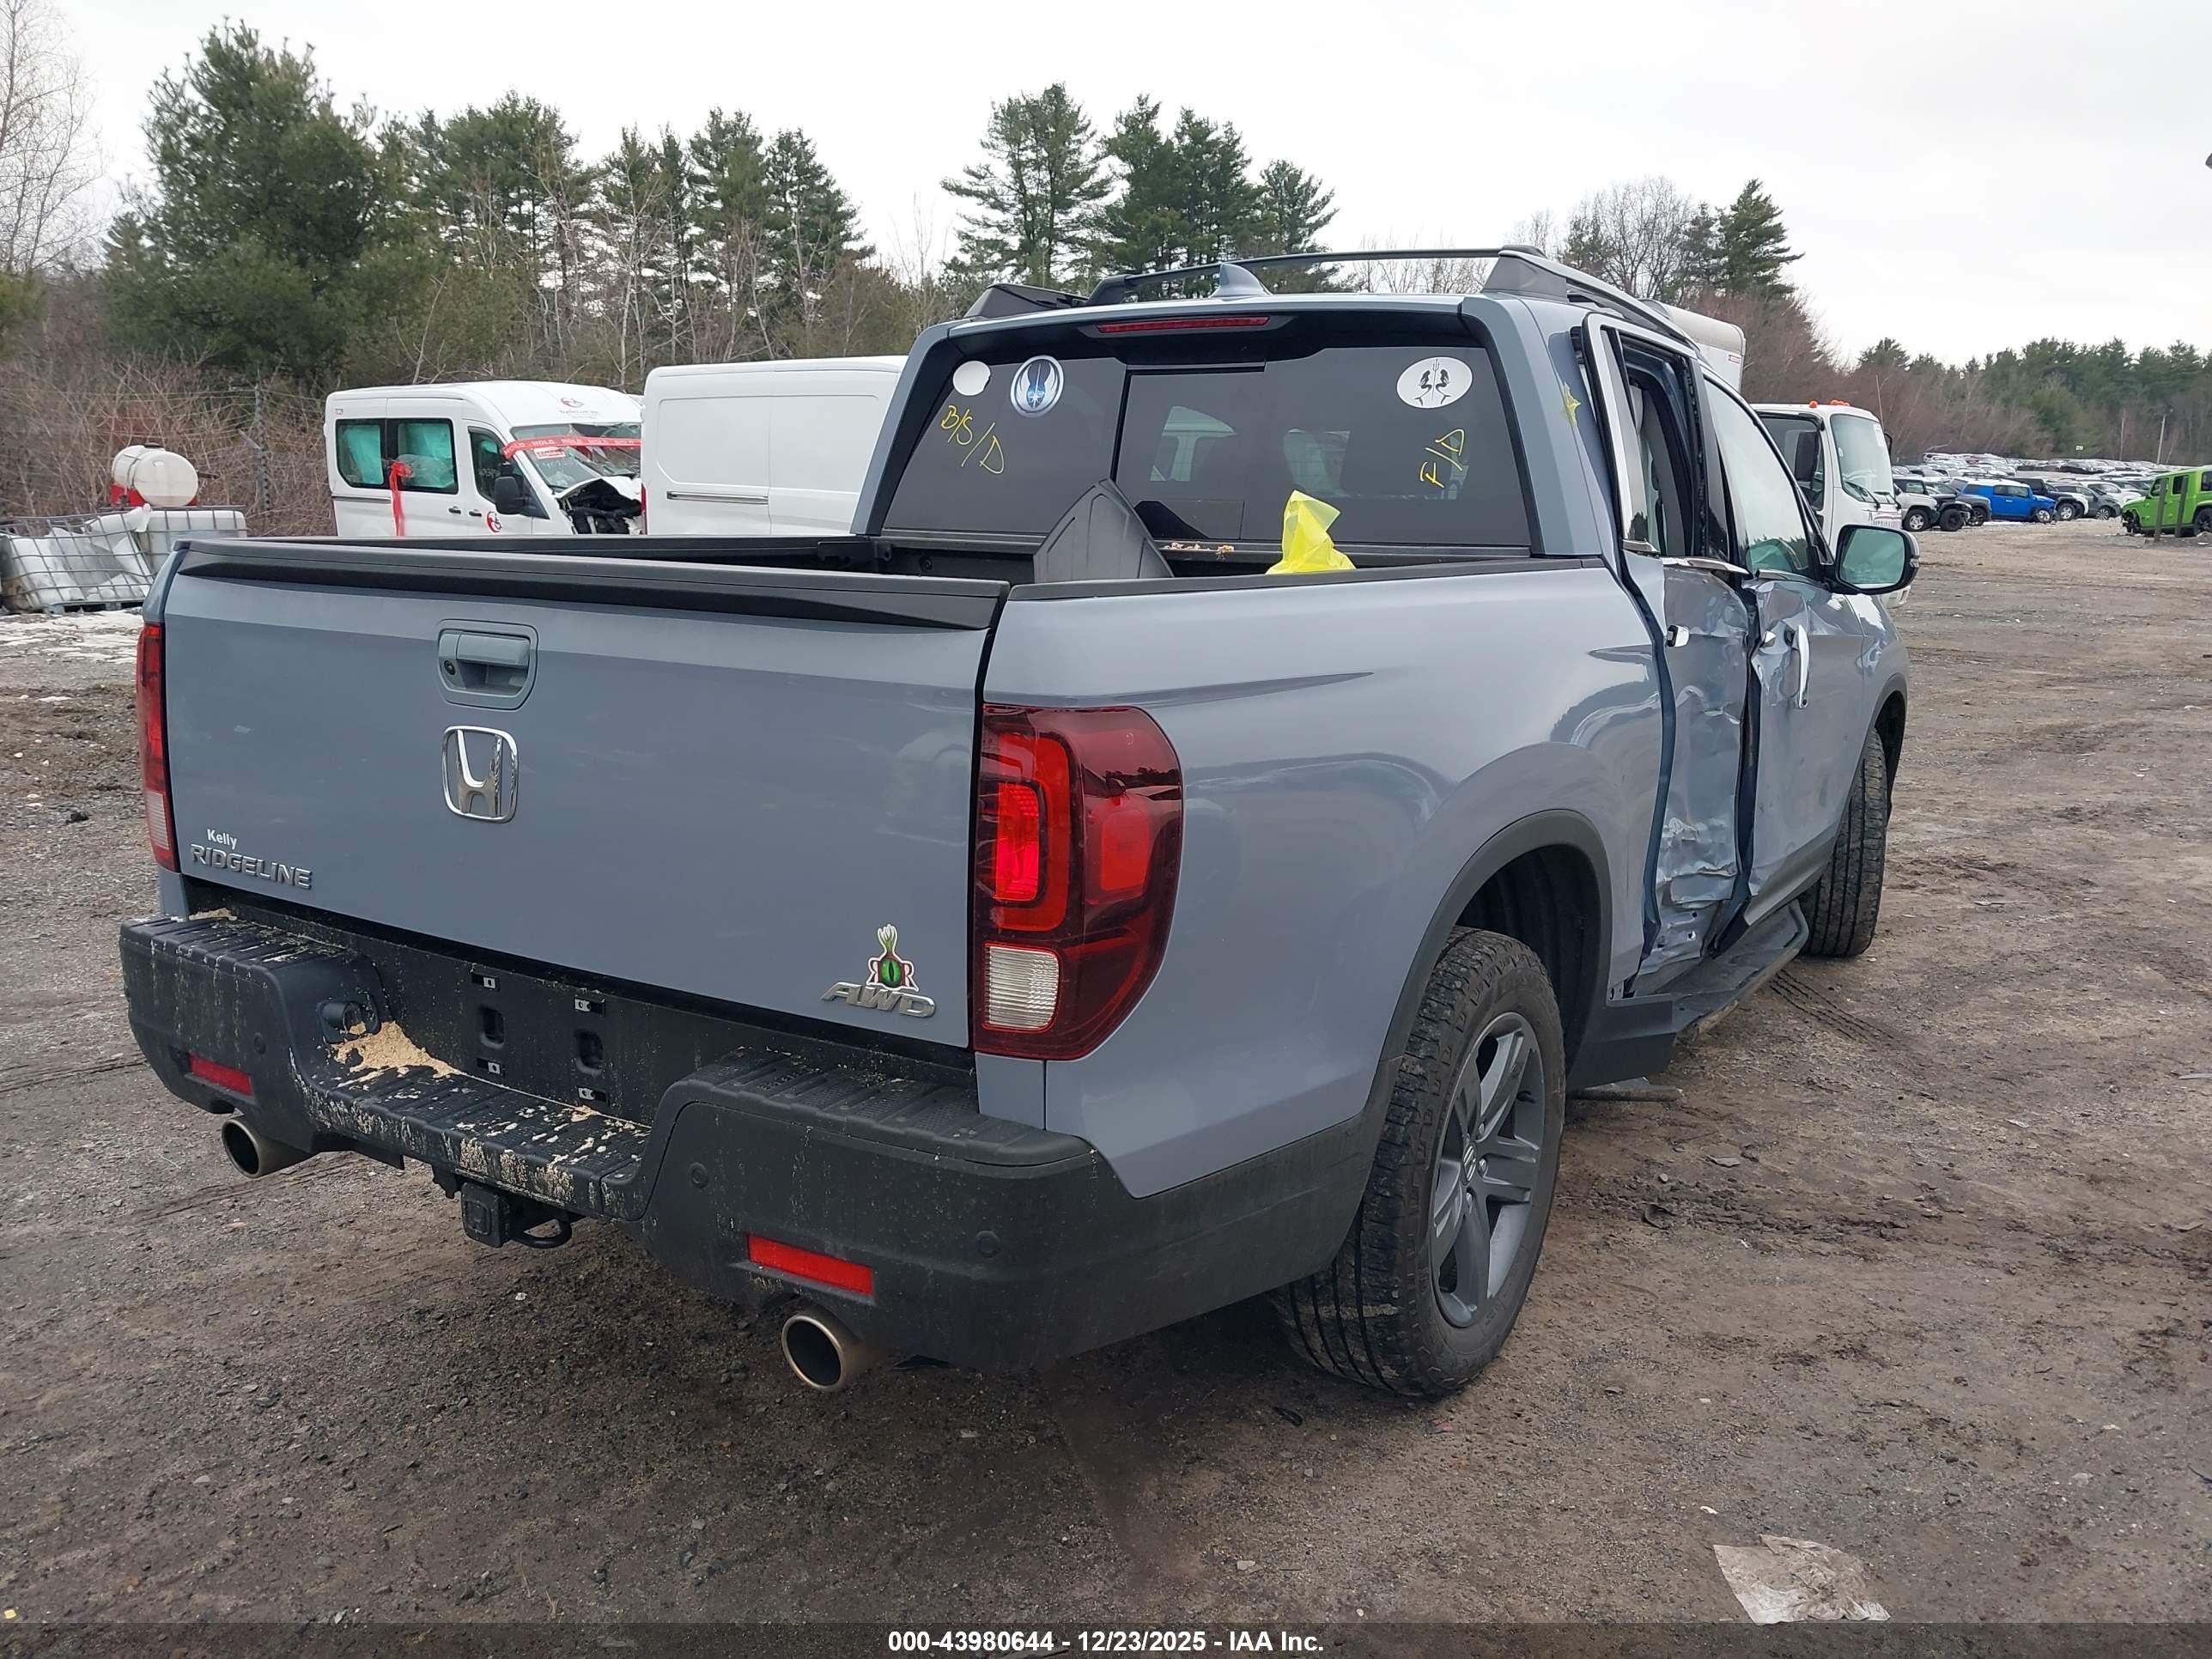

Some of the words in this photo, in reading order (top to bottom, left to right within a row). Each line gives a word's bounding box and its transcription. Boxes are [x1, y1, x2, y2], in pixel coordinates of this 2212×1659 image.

[206, 829, 238, 850] Kelly
[190, 843, 313, 890] RIDGELINE
[821, 981, 935, 1018] AWD
